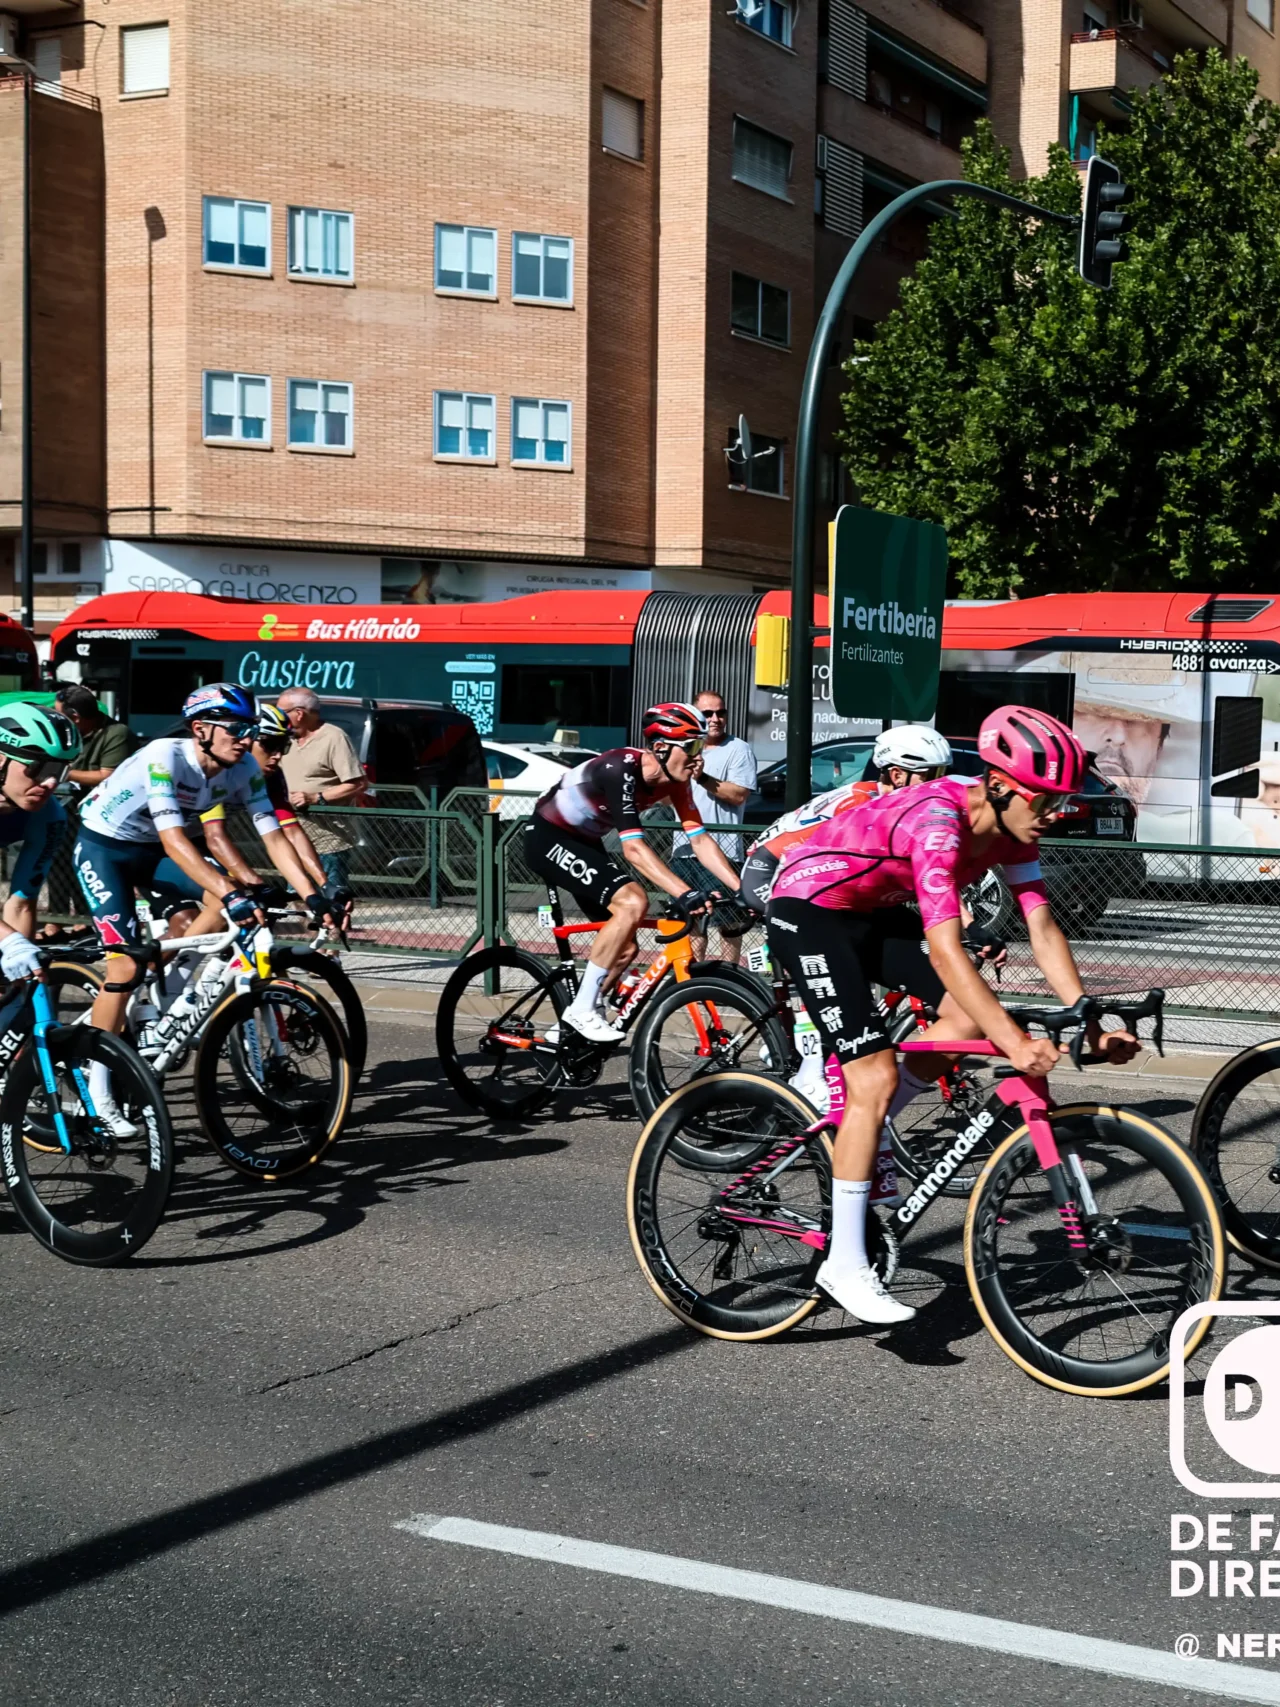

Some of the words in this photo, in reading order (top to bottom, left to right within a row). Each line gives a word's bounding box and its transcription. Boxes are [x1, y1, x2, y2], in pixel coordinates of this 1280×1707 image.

[306, 619, 343, 640] Bus
[842, 596, 936, 640] Fertiberia
[238, 651, 355, 690] Gustera
[841, 641, 904, 665] Fertilizantes
[1172, 654, 1205, 671] 4881
[1209, 657, 1267, 670] avanza
[622, 772, 635, 814] INEOS
[81, 860, 113, 905] BORA
[545, 843, 599, 886] INEOS
[749, 950, 764, 971] 185
[802, 1034, 818, 1056] 82
[896, 1107, 995, 1224] cannondale
